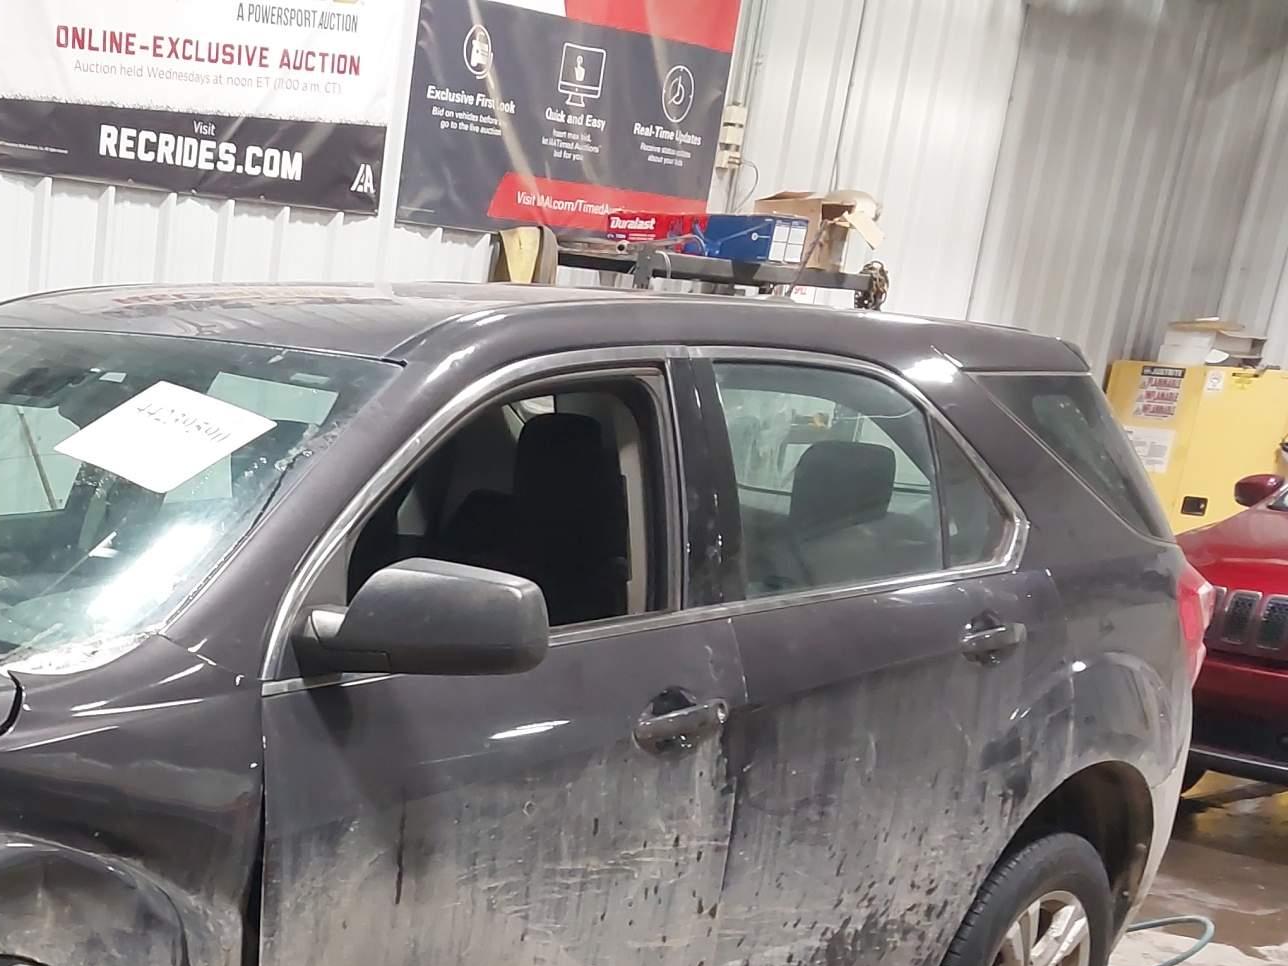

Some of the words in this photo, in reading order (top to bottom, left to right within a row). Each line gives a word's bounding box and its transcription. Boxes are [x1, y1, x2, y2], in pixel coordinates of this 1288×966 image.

[236, 2, 245, 21] A
[247, 3, 318, 28] POWERSPORT
[318, 10, 359, 33] AUCTION
[56, 25, 270, 68] ONLINE-EXCLUSIVE
[279, 48, 361, 76] AUCTION
[74, 59, 117, 75] Auction
[119, 64, 143, 78] held
[147, 66, 211, 85] Wednesdays
[212, 74, 223, 86] at
[226, 76, 253, 88] noon
[256, 76, 271, 88] ET
[426, 85, 474, 105] Exclusive
[496, 100, 516, 114] ook
[432, 106, 445, 116] Bid
[445, 109, 454, 118] on
[545, 107, 566, 123] Quick
[566, 114, 584, 125] and
[585, 115, 606, 132] Easy
[193, 119, 217, 136] Visit
[440, 120, 450, 129] go
[450, 121, 458, 129] to
[633, 122, 675, 141] Real-Time
[675, 129, 702, 146] Updates
[98, 123, 304, 181] RECRIDES.COM
[516, 191, 536, 206] Visit
[609, 216, 656, 231] Duralast
